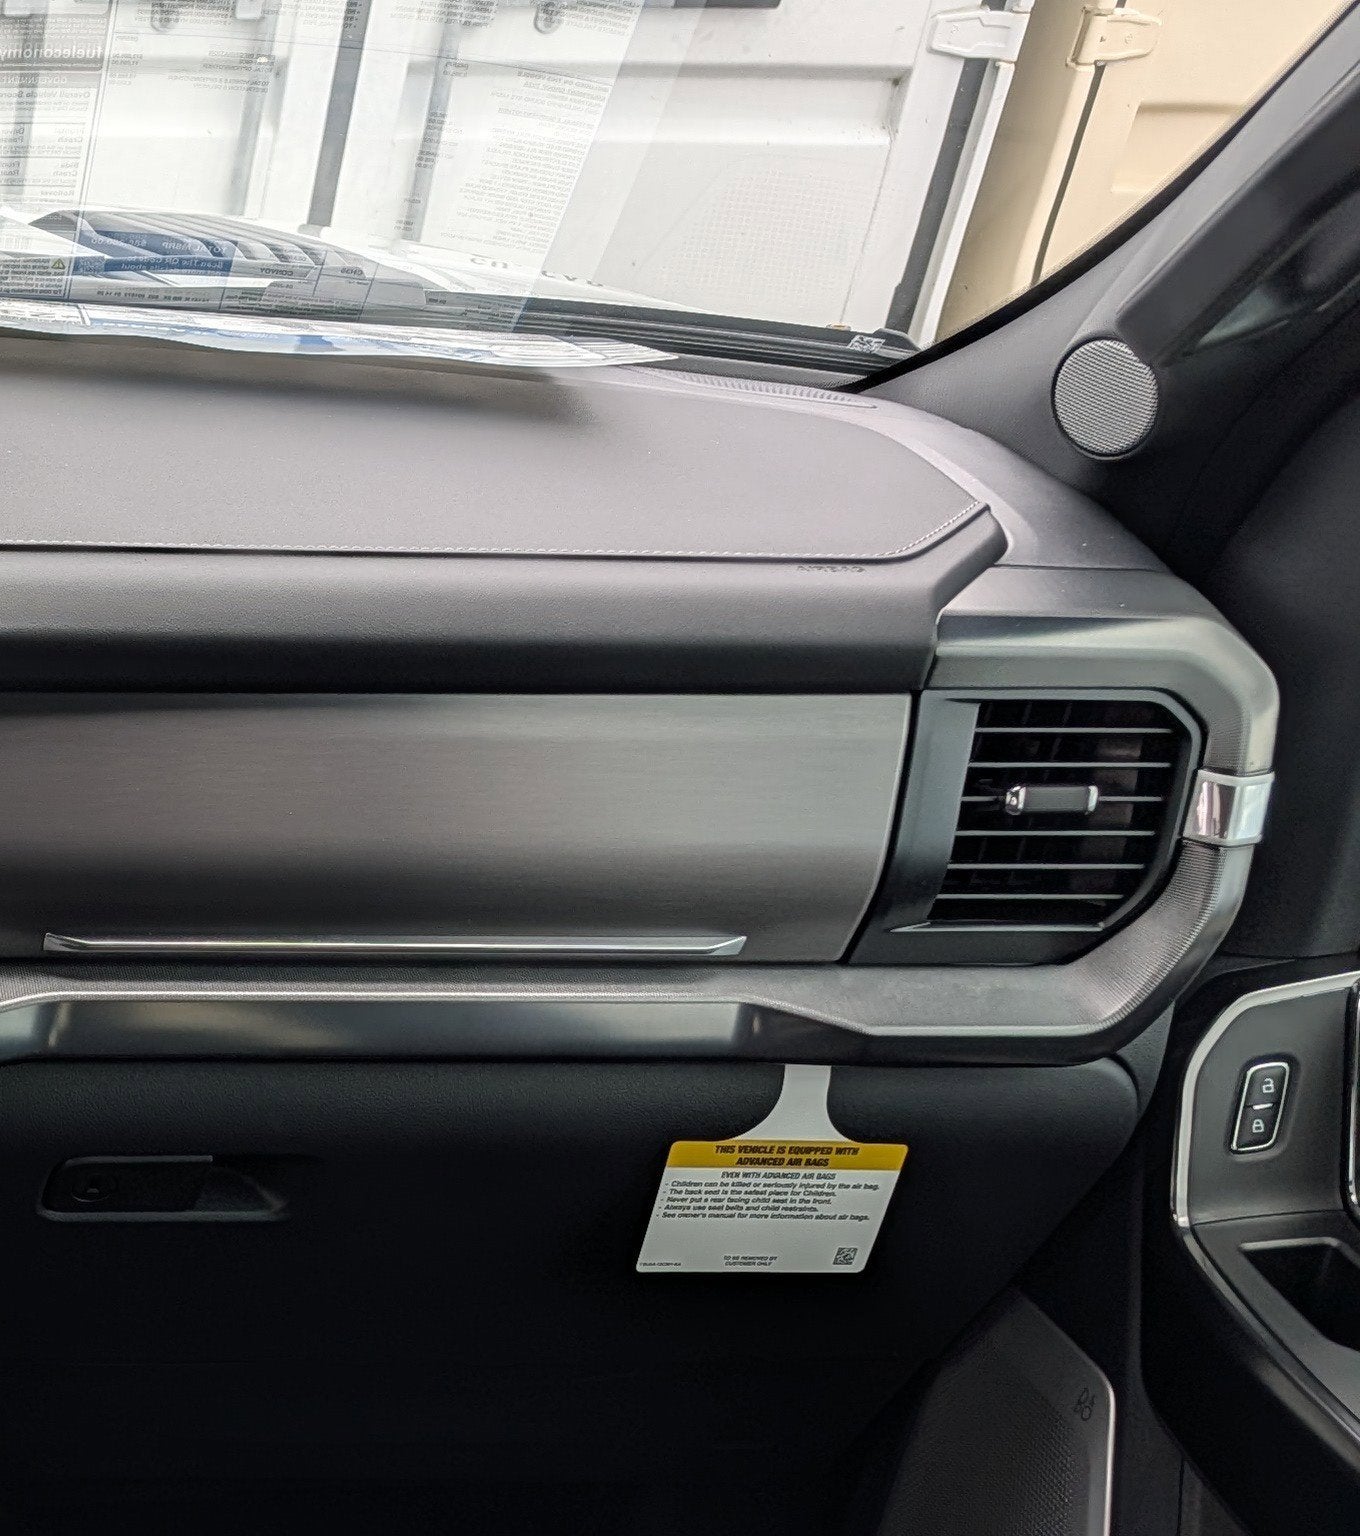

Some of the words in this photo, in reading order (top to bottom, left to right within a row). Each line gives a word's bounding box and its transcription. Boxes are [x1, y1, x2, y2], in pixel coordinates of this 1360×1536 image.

[715, 1145, 736, 1154] THIS
[737, 1145, 775, 1154] VEHICLE
[776, 1146, 787, 1154] IS
[788, 1146, 833, 1155] EQUIPPED
[835, 1147, 860, 1155] WITH
[735, 1157, 785, 1166] ADVANCED
[786, 1157, 802, 1166] AIR
[804, 1158, 830, 1167] BAGS
[721, 1171, 741, 1179] EVEN
[761, 1172, 800, 1180] ADVANCED
[801, 1172, 814, 1180] AIR
[762, 1182, 797, 1190] seriously
[799, 1182, 826, 1190] injured
